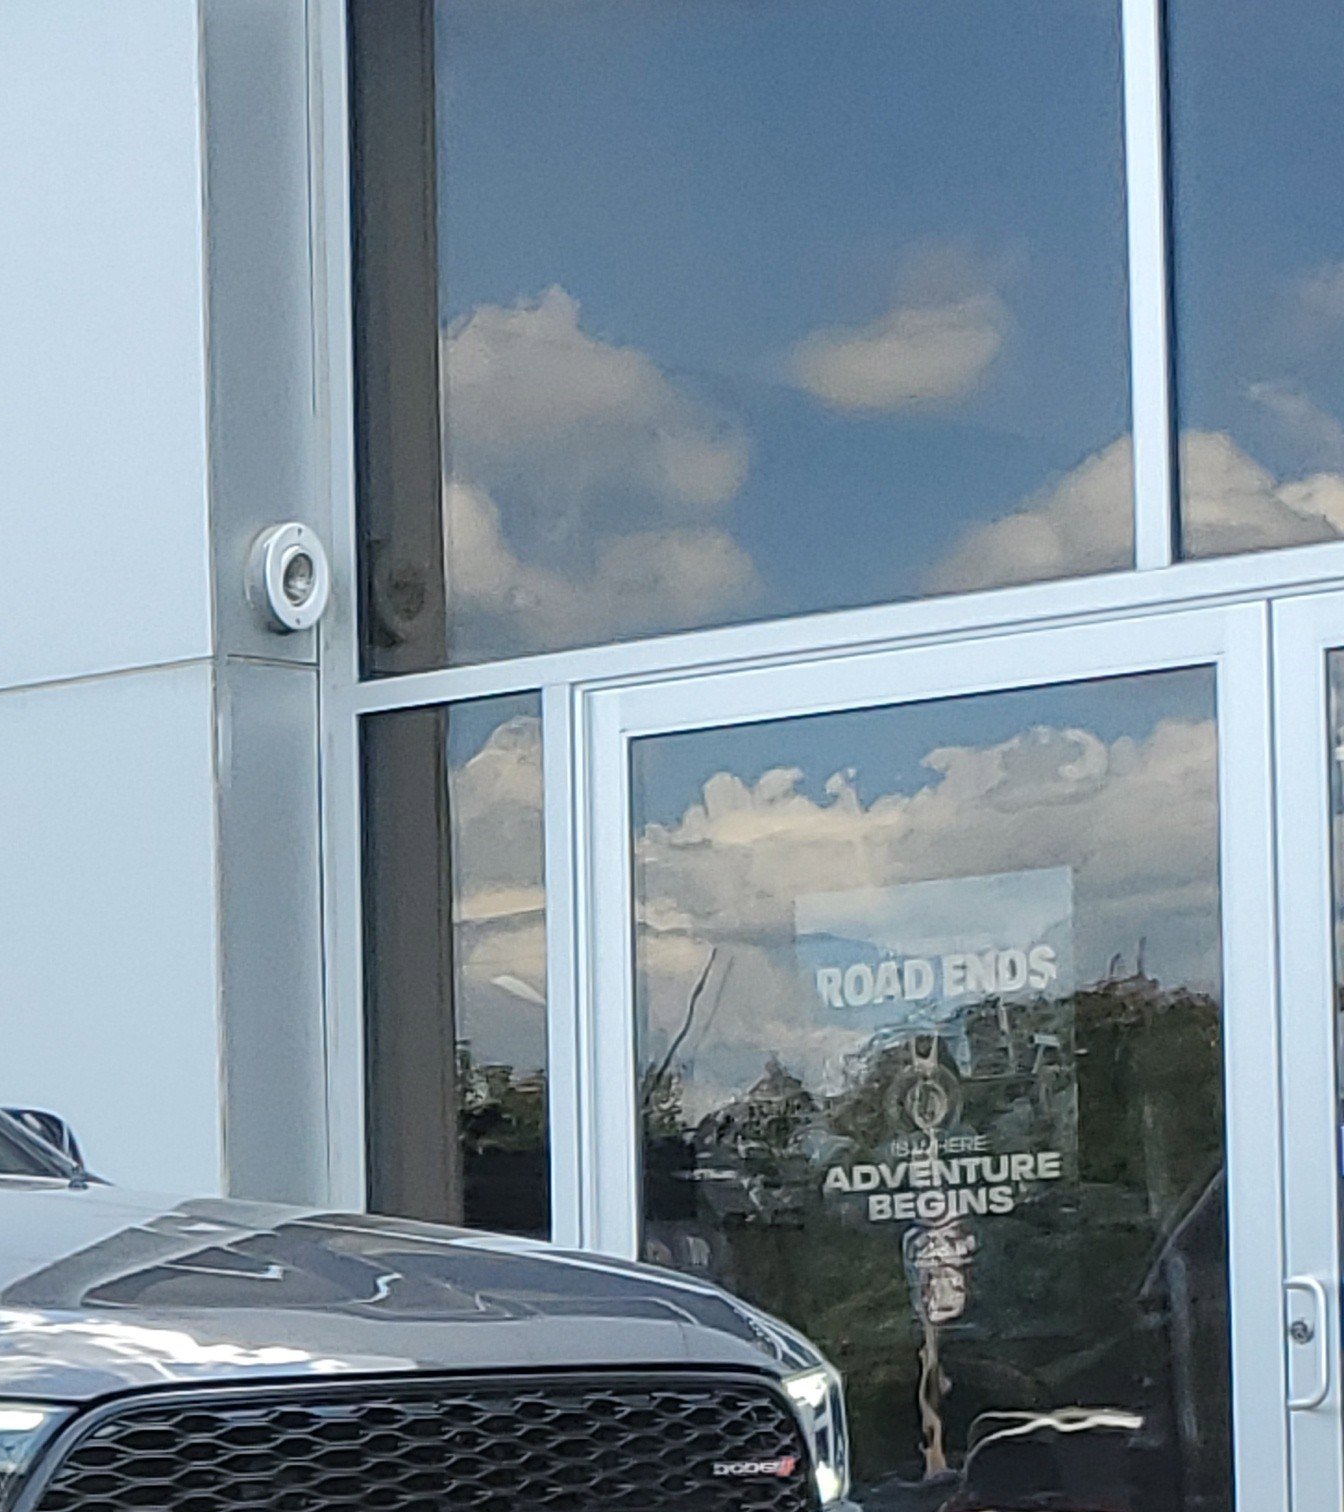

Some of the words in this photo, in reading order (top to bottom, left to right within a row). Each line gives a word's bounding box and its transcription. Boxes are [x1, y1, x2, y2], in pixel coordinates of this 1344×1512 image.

[816, 960, 934, 1008] ROAD
[942, 945, 1056, 997] ENDS
[823, 1151, 1062, 1193] ADVENTURE
[868, 1186, 1015, 1221] BEGINS
